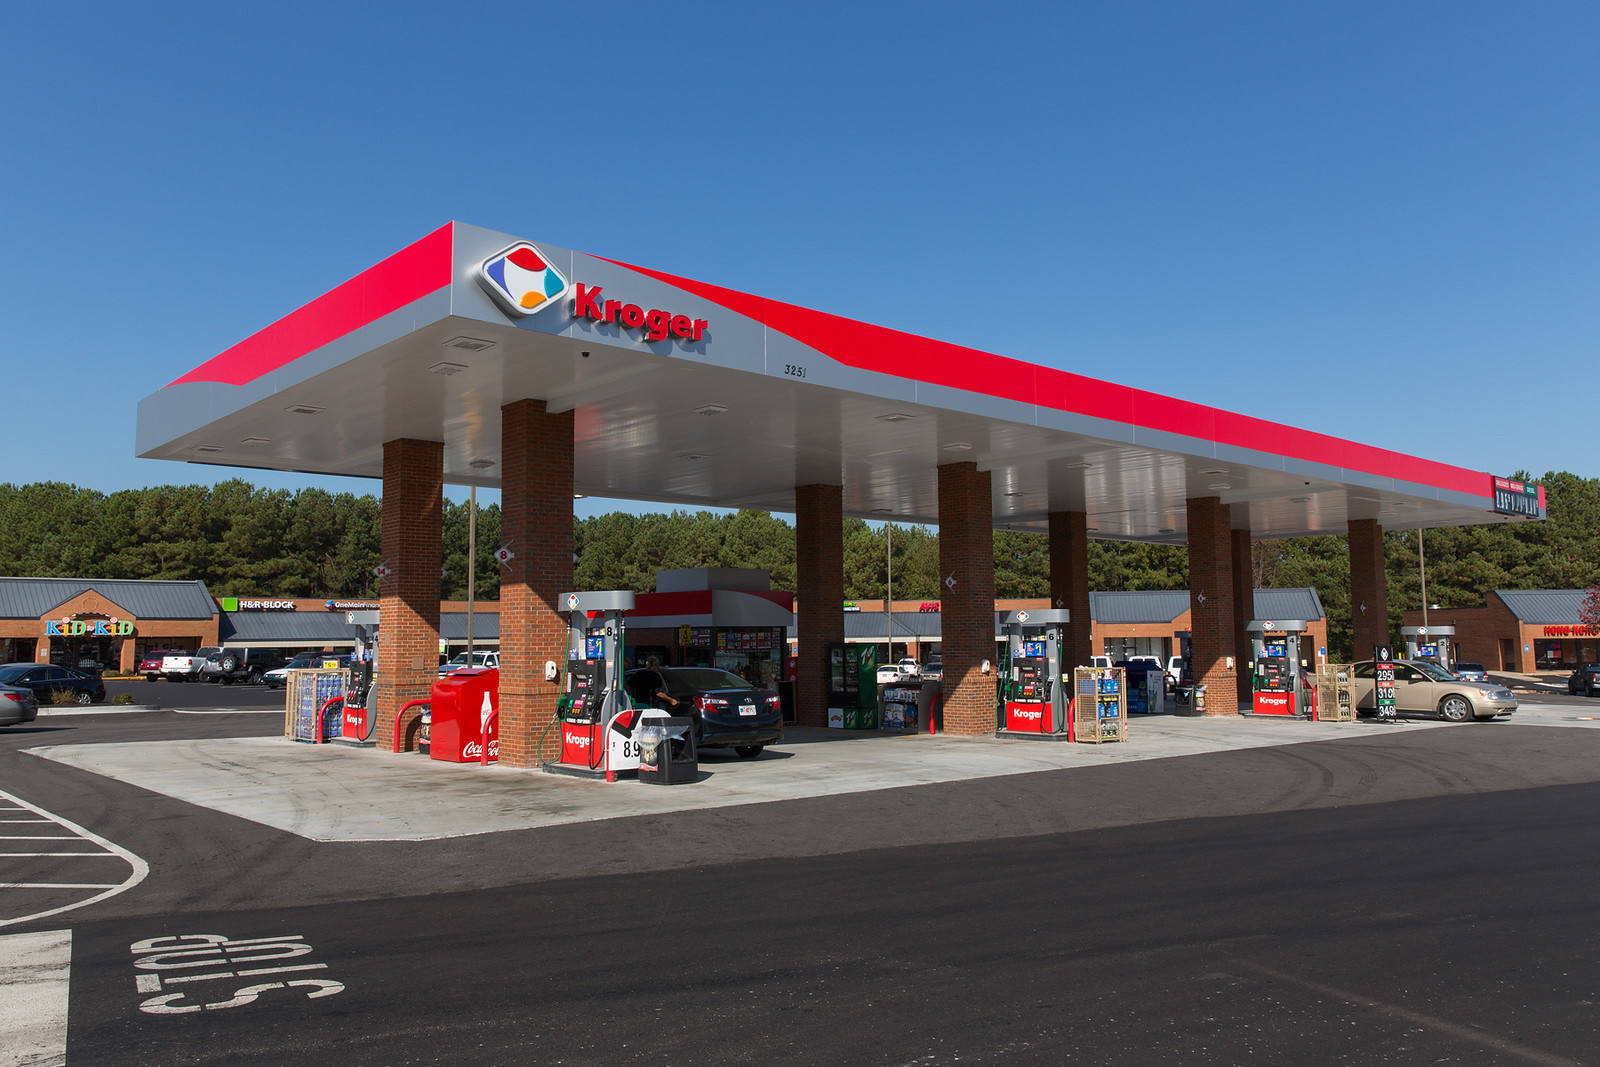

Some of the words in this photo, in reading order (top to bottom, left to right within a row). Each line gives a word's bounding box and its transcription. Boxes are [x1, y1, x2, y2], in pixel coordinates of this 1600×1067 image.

[576, 282, 708, 340] Kroger
[263, 600, 294, 609] BLOCK
[919, 602, 939, 611] AVIS
[606, 627, 613, 637] 8
[1048, 633, 1055, 641] 6
[1260, 697, 1287, 705] Kroger
[130, 934, 345, 1024] STOP
